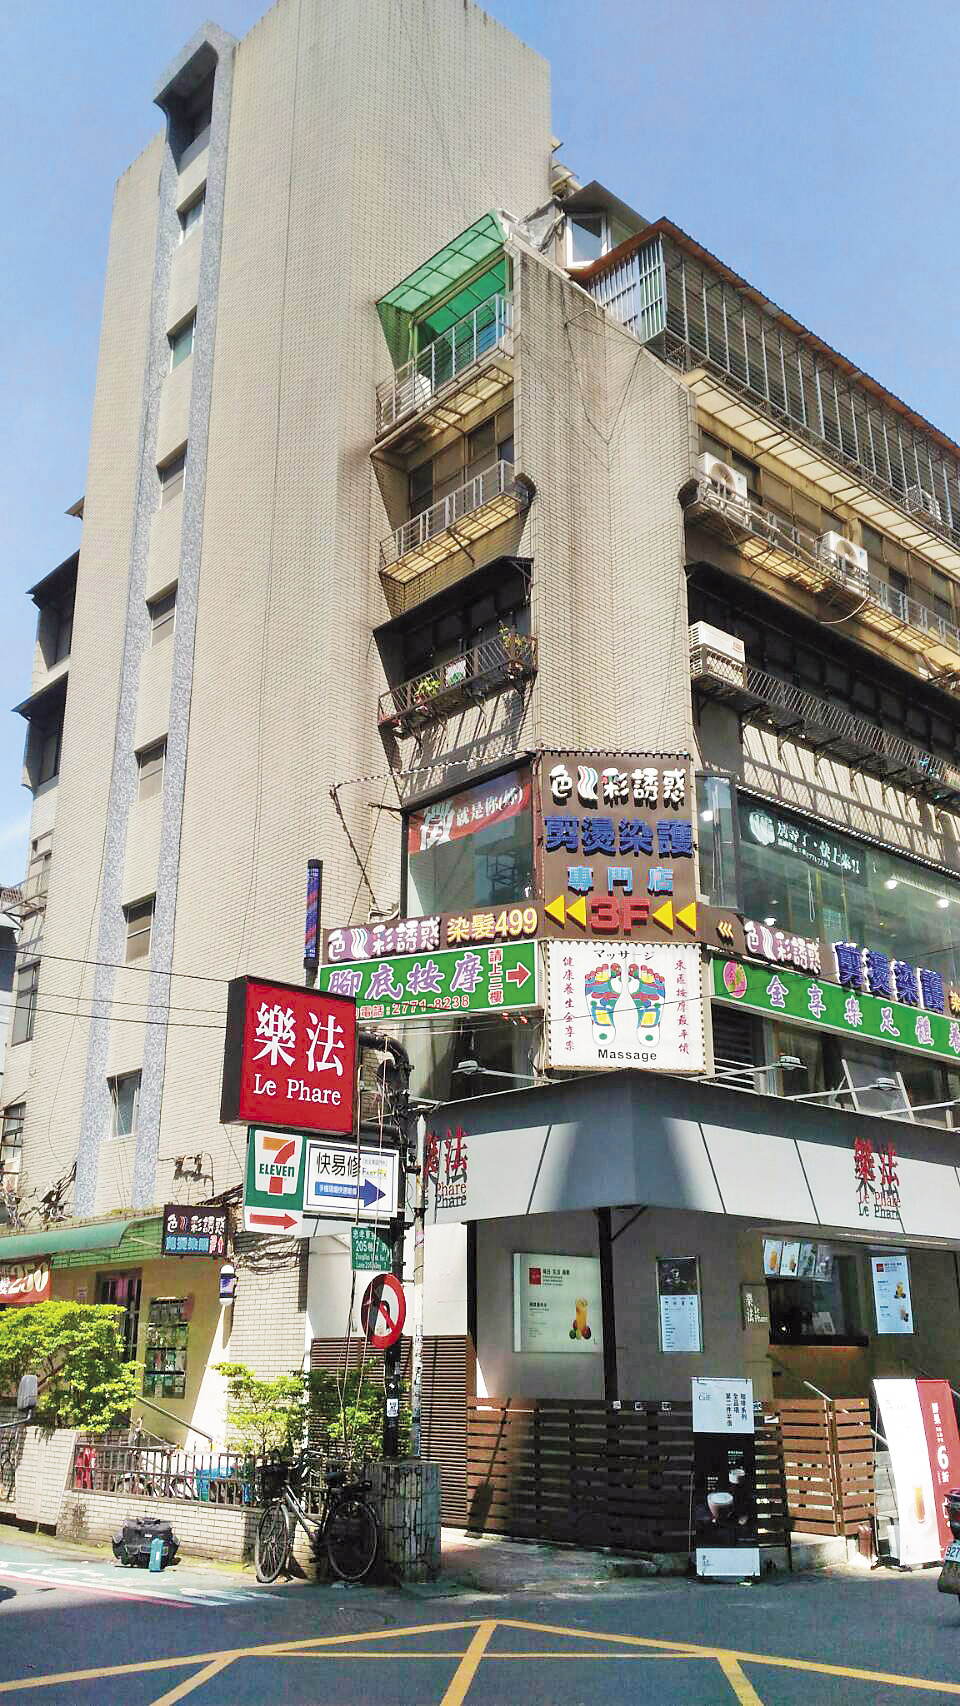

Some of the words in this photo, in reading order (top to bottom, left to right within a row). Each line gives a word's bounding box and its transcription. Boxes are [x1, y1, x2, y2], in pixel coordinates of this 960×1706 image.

[549, 764, 686, 801] 色彩誘惑
[544, 816, 693, 856] 剪燙染護
[567, 865, 673, 894] 專門店
[590, 897, 649, 933] 3F
[328, 916, 440, 961] 色彩誘惑
[447, 908, 537, 943] 染髮499
[594, 950, 655, 961] マッサージ
[252, 1002, 345, 1076] 樂法
[598, 1049, 657, 1062] Massage
[253, 1073, 277, 1096] Le
[286, 1078, 341, 1106] Phare
[317, 1151, 361, 1177] 快易修
